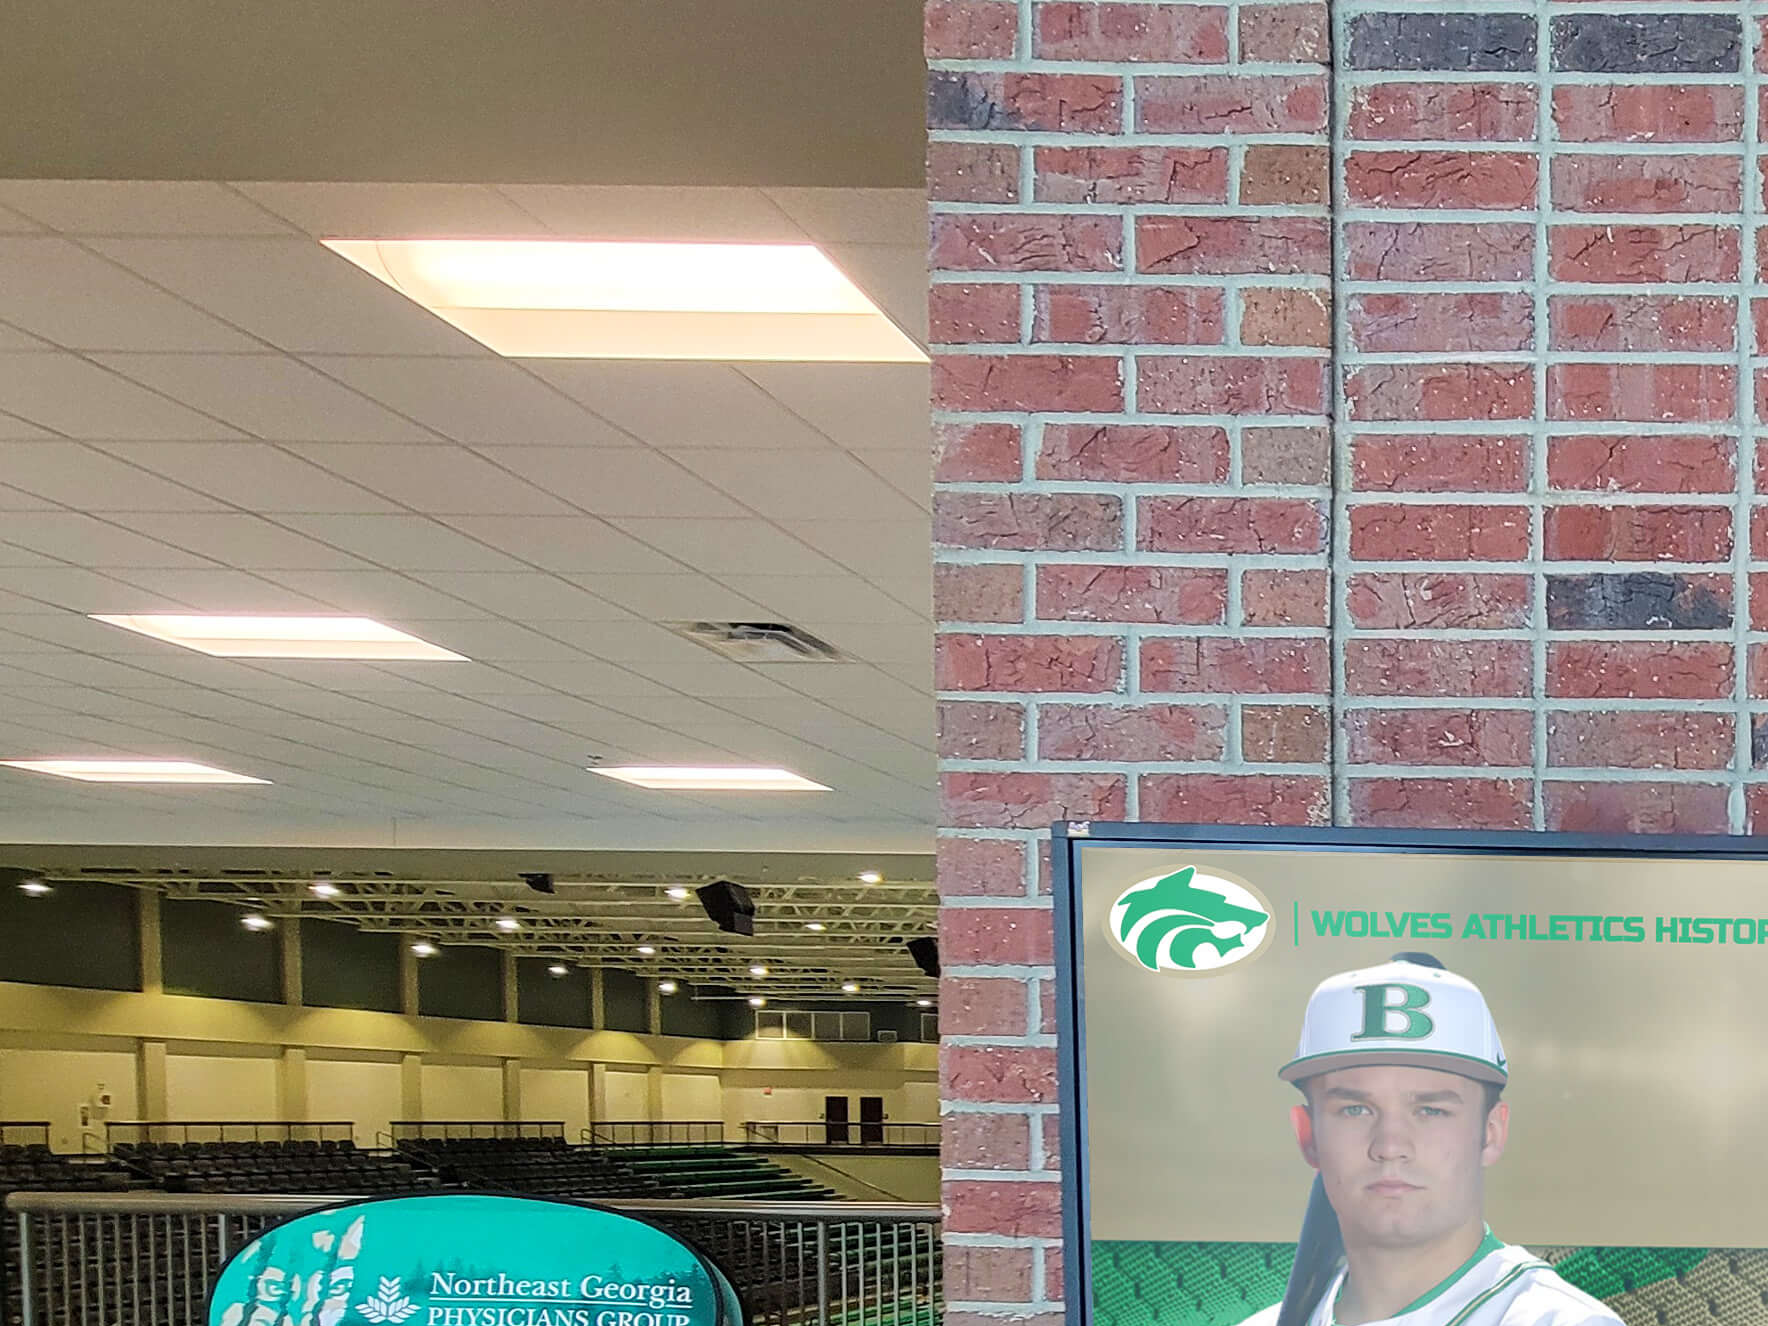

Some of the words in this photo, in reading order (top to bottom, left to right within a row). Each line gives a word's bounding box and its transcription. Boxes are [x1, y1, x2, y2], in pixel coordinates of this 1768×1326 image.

[1311, 909, 1453, 940] WOLVES
[1461, 912, 1646, 943] ATHLETICS
[1350, 982, 1436, 1043] B
[429, 1271, 571, 1298] Northeast
[580, 1274, 692, 1308] Georgia
